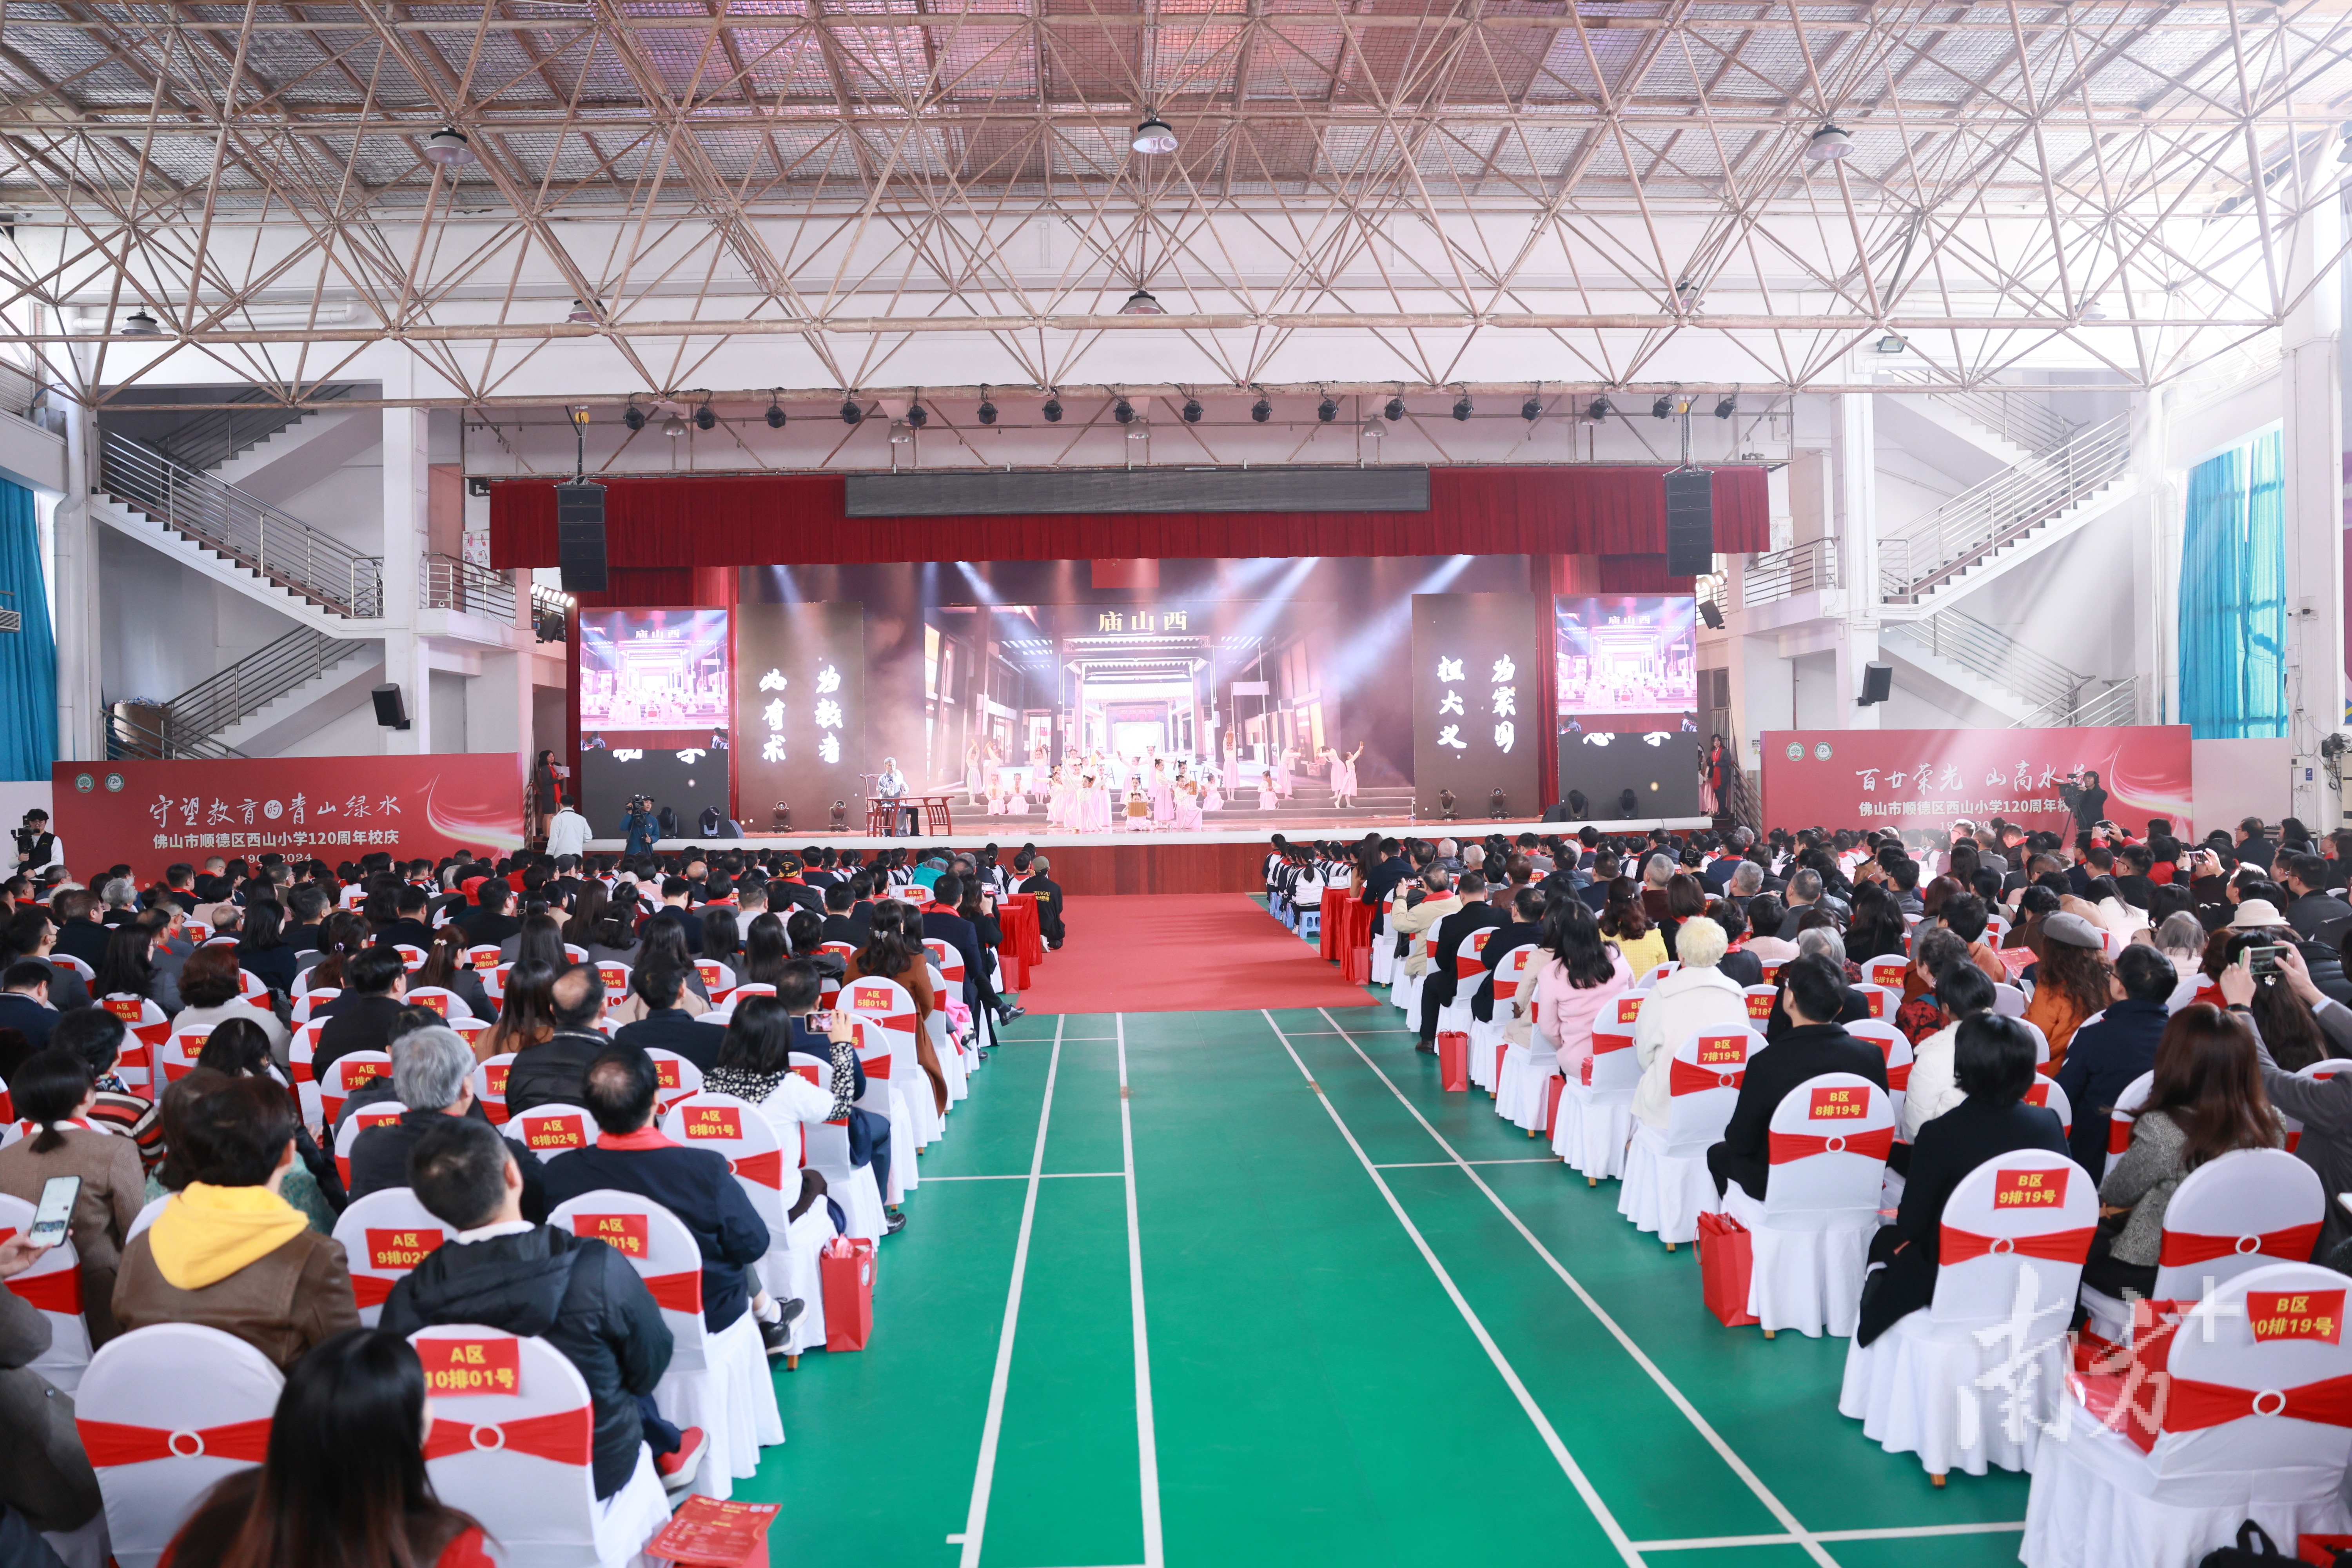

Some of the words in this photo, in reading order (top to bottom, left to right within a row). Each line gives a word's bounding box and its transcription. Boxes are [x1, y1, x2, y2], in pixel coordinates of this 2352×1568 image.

[149, 792, 401, 828] 守望教育的青山绿水
[1859, 798, 2070, 816] 佛山市顺德区西山小学120周年校
[153, 829, 399, 849] 佛山市顺德区西山小学120周年校庆
[1715, 1040, 1731, 1049] B区
[1703, 1051, 1740, 1061] 7排19号
[359, 1065, 376, 1074] A区
[1830, 1091, 1849, 1102] B区
[701, 1111, 721, 1122] A区
[1815, 1105, 1861, 1116] 8排19号
[543, 1120, 563, 1131] A区
[689, 1124, 734, 1136] 8排01号
[532, 1133, 578, 1145] 8排02号
[2018, 1174, 2043, 1187] B区
[2000, 1190, 2056, 1204] 9排19号
[599, 1218, 624, 1232] A区
[392, 1233, 419, 1247] A区
[2276, 1296, 2310, 1313] B区
[450, 1345, 486, 1364] A区
[425, 1368, 514, 1388] 10排01号
